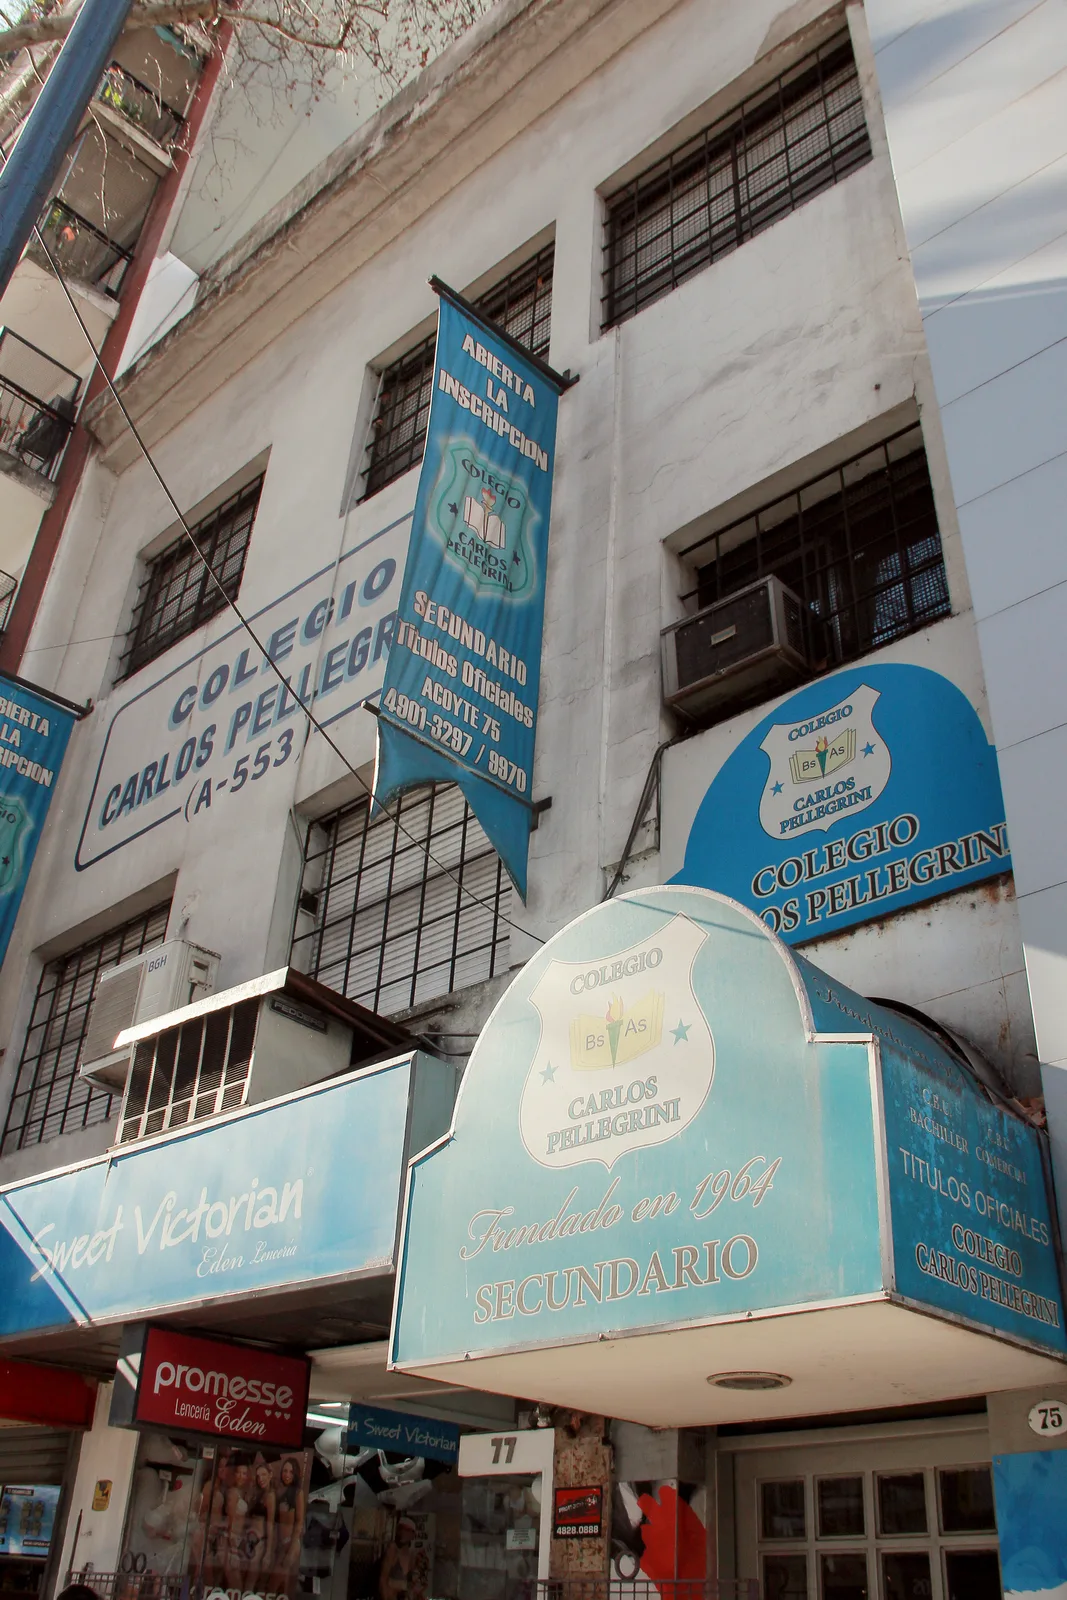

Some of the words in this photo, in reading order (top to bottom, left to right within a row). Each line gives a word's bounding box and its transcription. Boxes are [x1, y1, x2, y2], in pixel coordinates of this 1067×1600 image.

[462, 333, 536, 408] ABIERTA
[486, 378, 508, 413] LA
[438, 369, 548, 472] INSCRIPCION
[462, 459, 520, 509] COLEGIO
[447, 539, 513, 593] PELLEGRINI
[459, 532, 507, 571] CARLOS
[170, 558, 397, 729] COLEGIO
[414, 590, 527, 686] SECUNDARIO
[422, 677, 479, 729] ACOYTE
[483, 713, 500, 742] 75
[462, 660, 534, 729] Oficiales
[0, 723, 21, 747] LA
[383, 688, 473, 757] 4901-3297
[488, 750, 527, 793] 9970
[788, 704, 853, 742] COLEGIO
[100, 724, 216, 829] CARLOS
[802, 758, 816, 772] Bs
[828, 744, 845, 760] As
[779, 786, 872, 835] PELLEGRINI
[793, 776, 856, 812] CARLOS
[752, 812, 920, 899] COLEGIO
[148, 954, 168, 973] BGH
[570, 947, 663, 995] COLEGIO
[585, 1034, 605, 1051] Bs
[624, 1018, 647, 1037] As
[568, 1075, 658, 1120] CARLOS
[546, 1097, 681, 1155] PELLEGRINI
[909, 1107, 969, 1155] BACHILLER
[459, 1176, 625, 1260] Fundado
[631, 1191, 681, 1223] en
[689, 1155, 783, 1220] 1964
[899, 1146, 970, 1208] TITULOS
[975, 1190, 1049, 1246] OFICIALES
[30, 1204, 124, 1282] Sweet
[135, 1178, 304, 1254] Victorian
[951, 1223, 1022, 1278] COLEGIO
[196, 1245, 244, 1279] Eden
[473, 1233, 759, 1325] SECUNDARIO
[915, 1242, 977, 1295] CARLOS
[980, 1271, 1060, 1328] PELLEGRINI
[154, 1361, 293, 1409] promesse
[175, 1398, 210, 1421] Lencería
[214, 1397, 267, 1436] Eden
[364, 1418, 401, 1440] Sweet
[405, 1426, 456, 1451] Victorian
[1038, 1407, 1063, 1429] 75
[490, 1437, 517, 1464] 77
